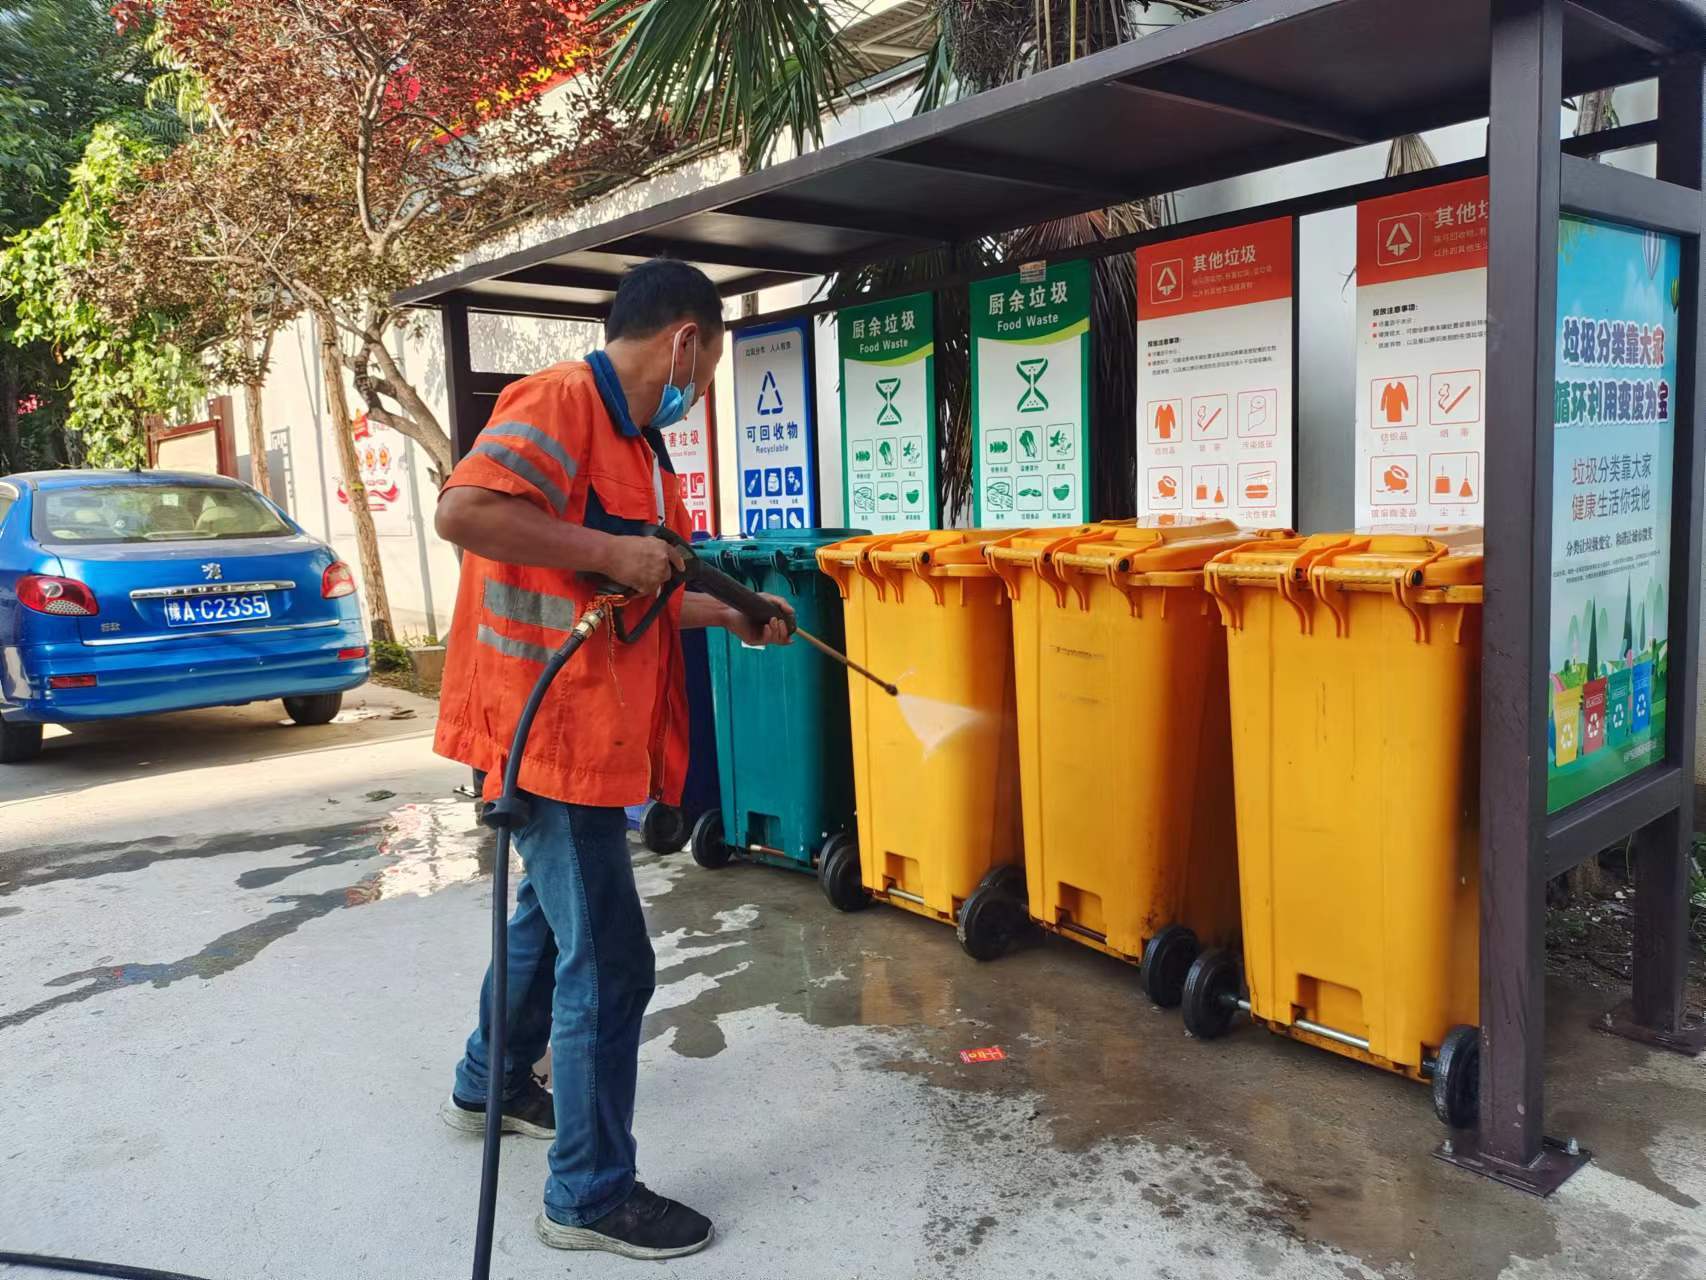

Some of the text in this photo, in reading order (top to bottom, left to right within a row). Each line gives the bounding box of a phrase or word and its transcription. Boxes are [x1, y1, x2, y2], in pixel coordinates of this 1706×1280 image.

[1193, 244, 1257, 273] 其他垃圾
[989, 281, 1068, 315] 厨余垃圾
[852, 310, 916, 339] 厨余垃圾
[997, 313, 1059, 333] Food Waste
[859, 339, 908, 354] Food Waste
[1562, 318, 1665, 365] 垃圾分类靠大家
[1555, 380, 1668, 424] 循环利用变废为宝
[746, 421, 798, 443] 可回收物
[755, 444, 789, 454] Recyclable
[1572, 452, 1652, 485] 垃圾分类靠大家
[1571, 484, 1651, 522] 健康生活你我他
